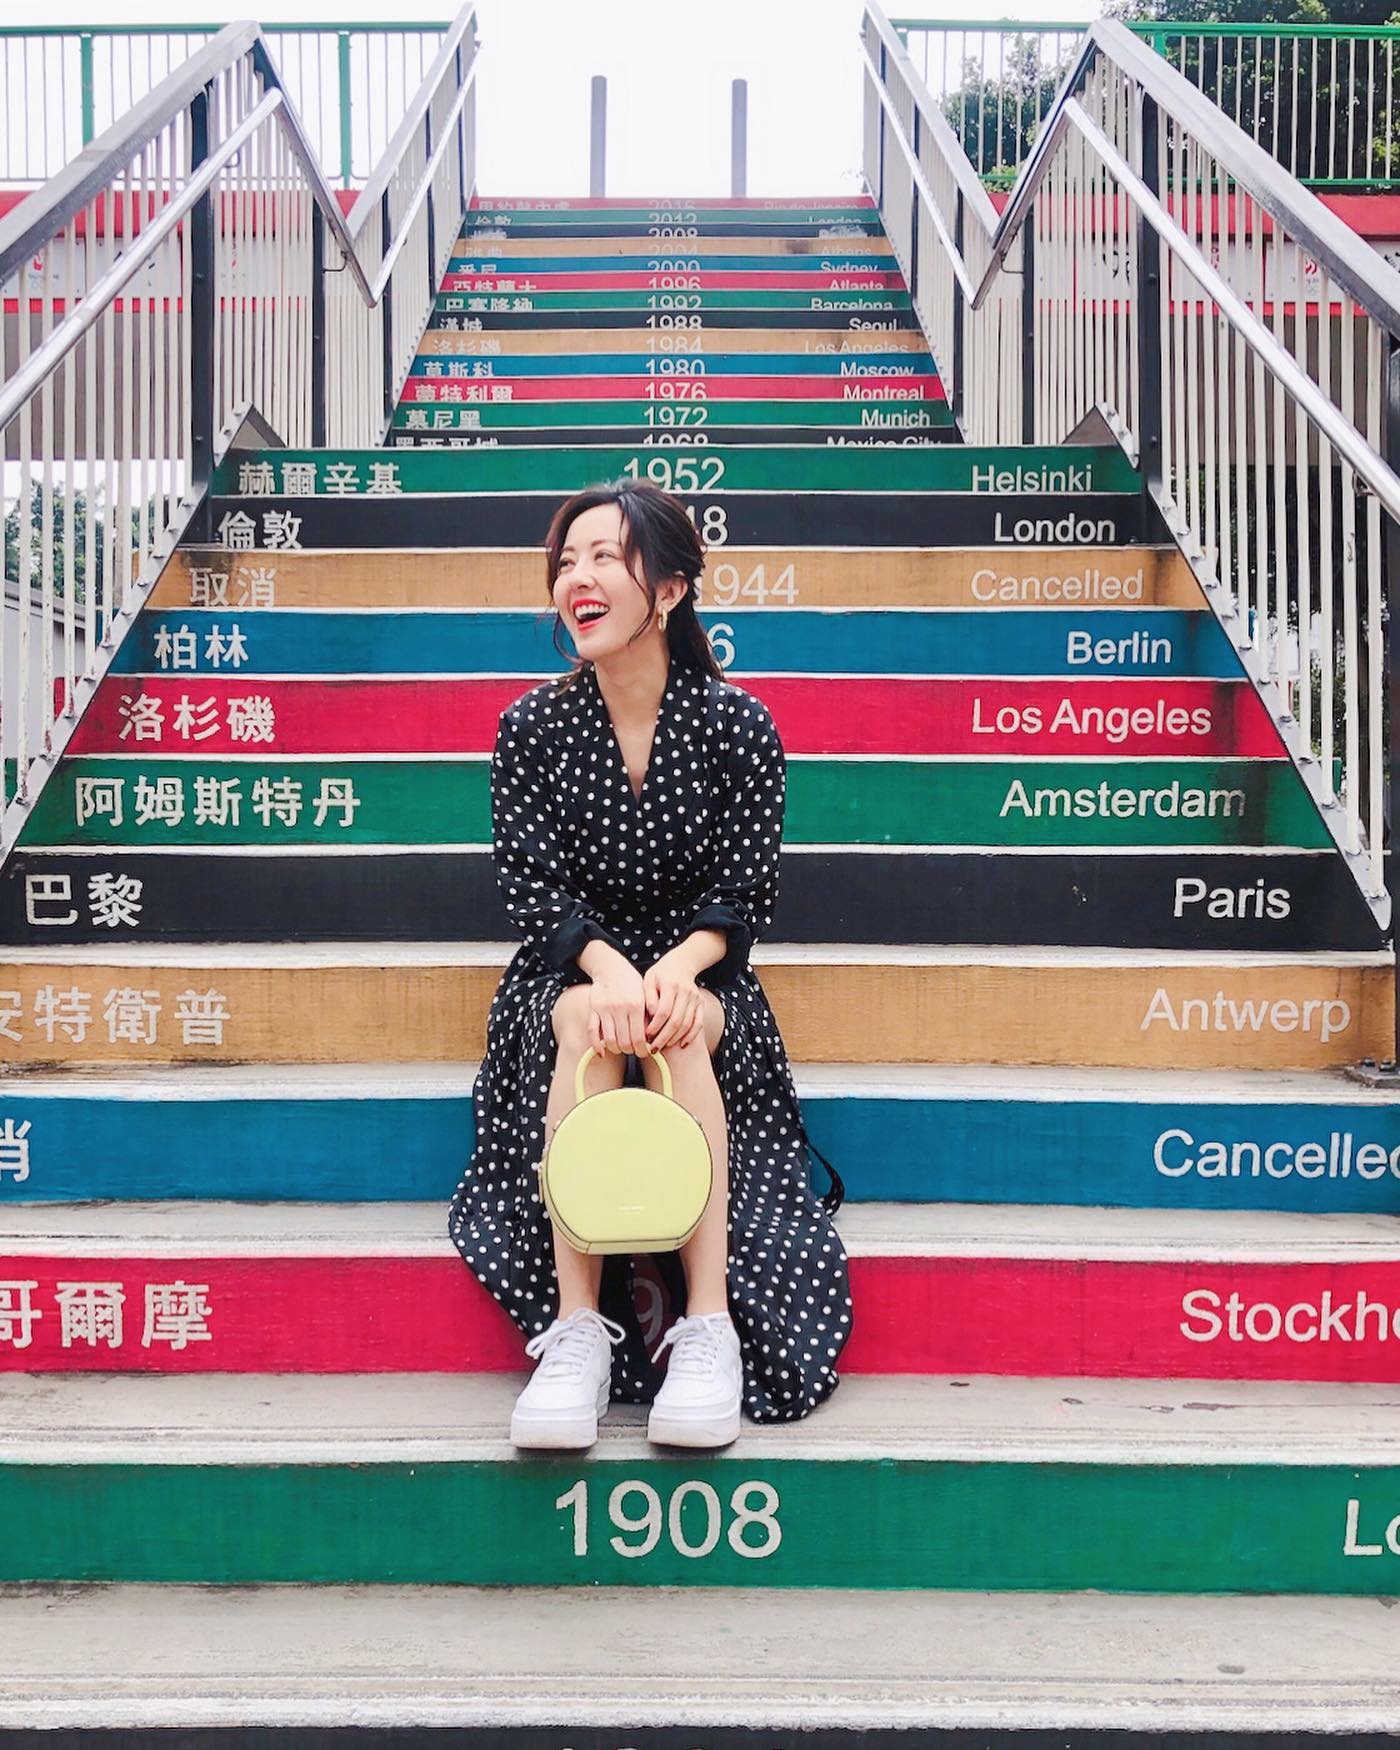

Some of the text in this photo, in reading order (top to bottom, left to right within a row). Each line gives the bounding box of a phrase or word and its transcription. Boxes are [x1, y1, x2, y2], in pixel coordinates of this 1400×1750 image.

[839, 361, 915, 377] Moscow
[644, 381, 707, 401] 1976
[843, 384, 924, 400] Montreal
[643, 405, 708, 427] 1972
[861, 408, 931, 427] Munich
[623, 456, 725, 492] 1952
[971, 464, 1093, 493] Helsinki
[217, 509, 303, 550] 倫敦
[994, 512, 1116, 543] London
[190, 566, 278, 608] 取消
[970, 569, 1144, 602] Cancelled
[153, 624, 249, 670] 柏林
[1066, 630, 1173, 666] Berlin
[117, 694, 277, 744] 洛杉磯
[971, 698, 1213, 745] Los Angeles
[75, 776, 361, 828] 阿姆斯特丹
[999, 779, 1246, 818] Amsterdam
[24, 872, 144, 929] 巴黎
[1172, 877, 1292, 921] Paris
[1140, 987, 1352, 1045] Antwerp
[1179, 1288, 1400, 1343] Stockh
[555, 1479, 783, 1559] 1908
